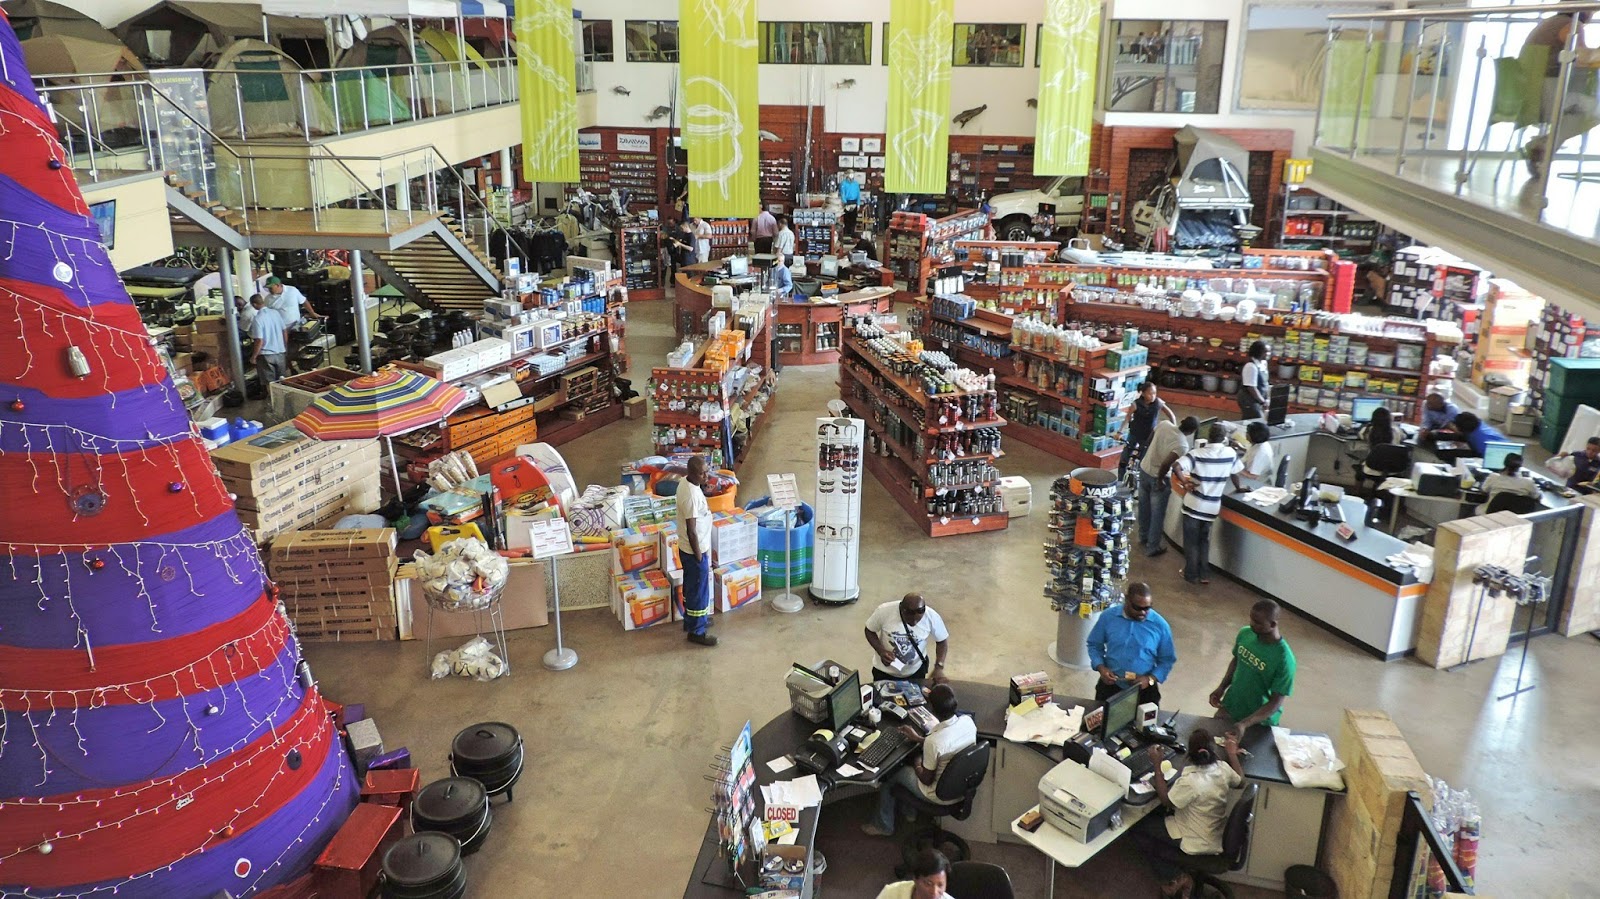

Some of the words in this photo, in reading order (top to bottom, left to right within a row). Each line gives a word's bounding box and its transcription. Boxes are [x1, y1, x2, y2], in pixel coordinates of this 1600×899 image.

[266, 451, 291, 467] medalist
[266, 467, 292, 483] medalist
[270, 485, 295, 502] medalist
[268, 519, 294, 535] medalist
[1238, 645, 1266, 670] GUESS
[1087, 711, 1104, 729] CLOSE
[767, 807, 796, 821] CLOSED
